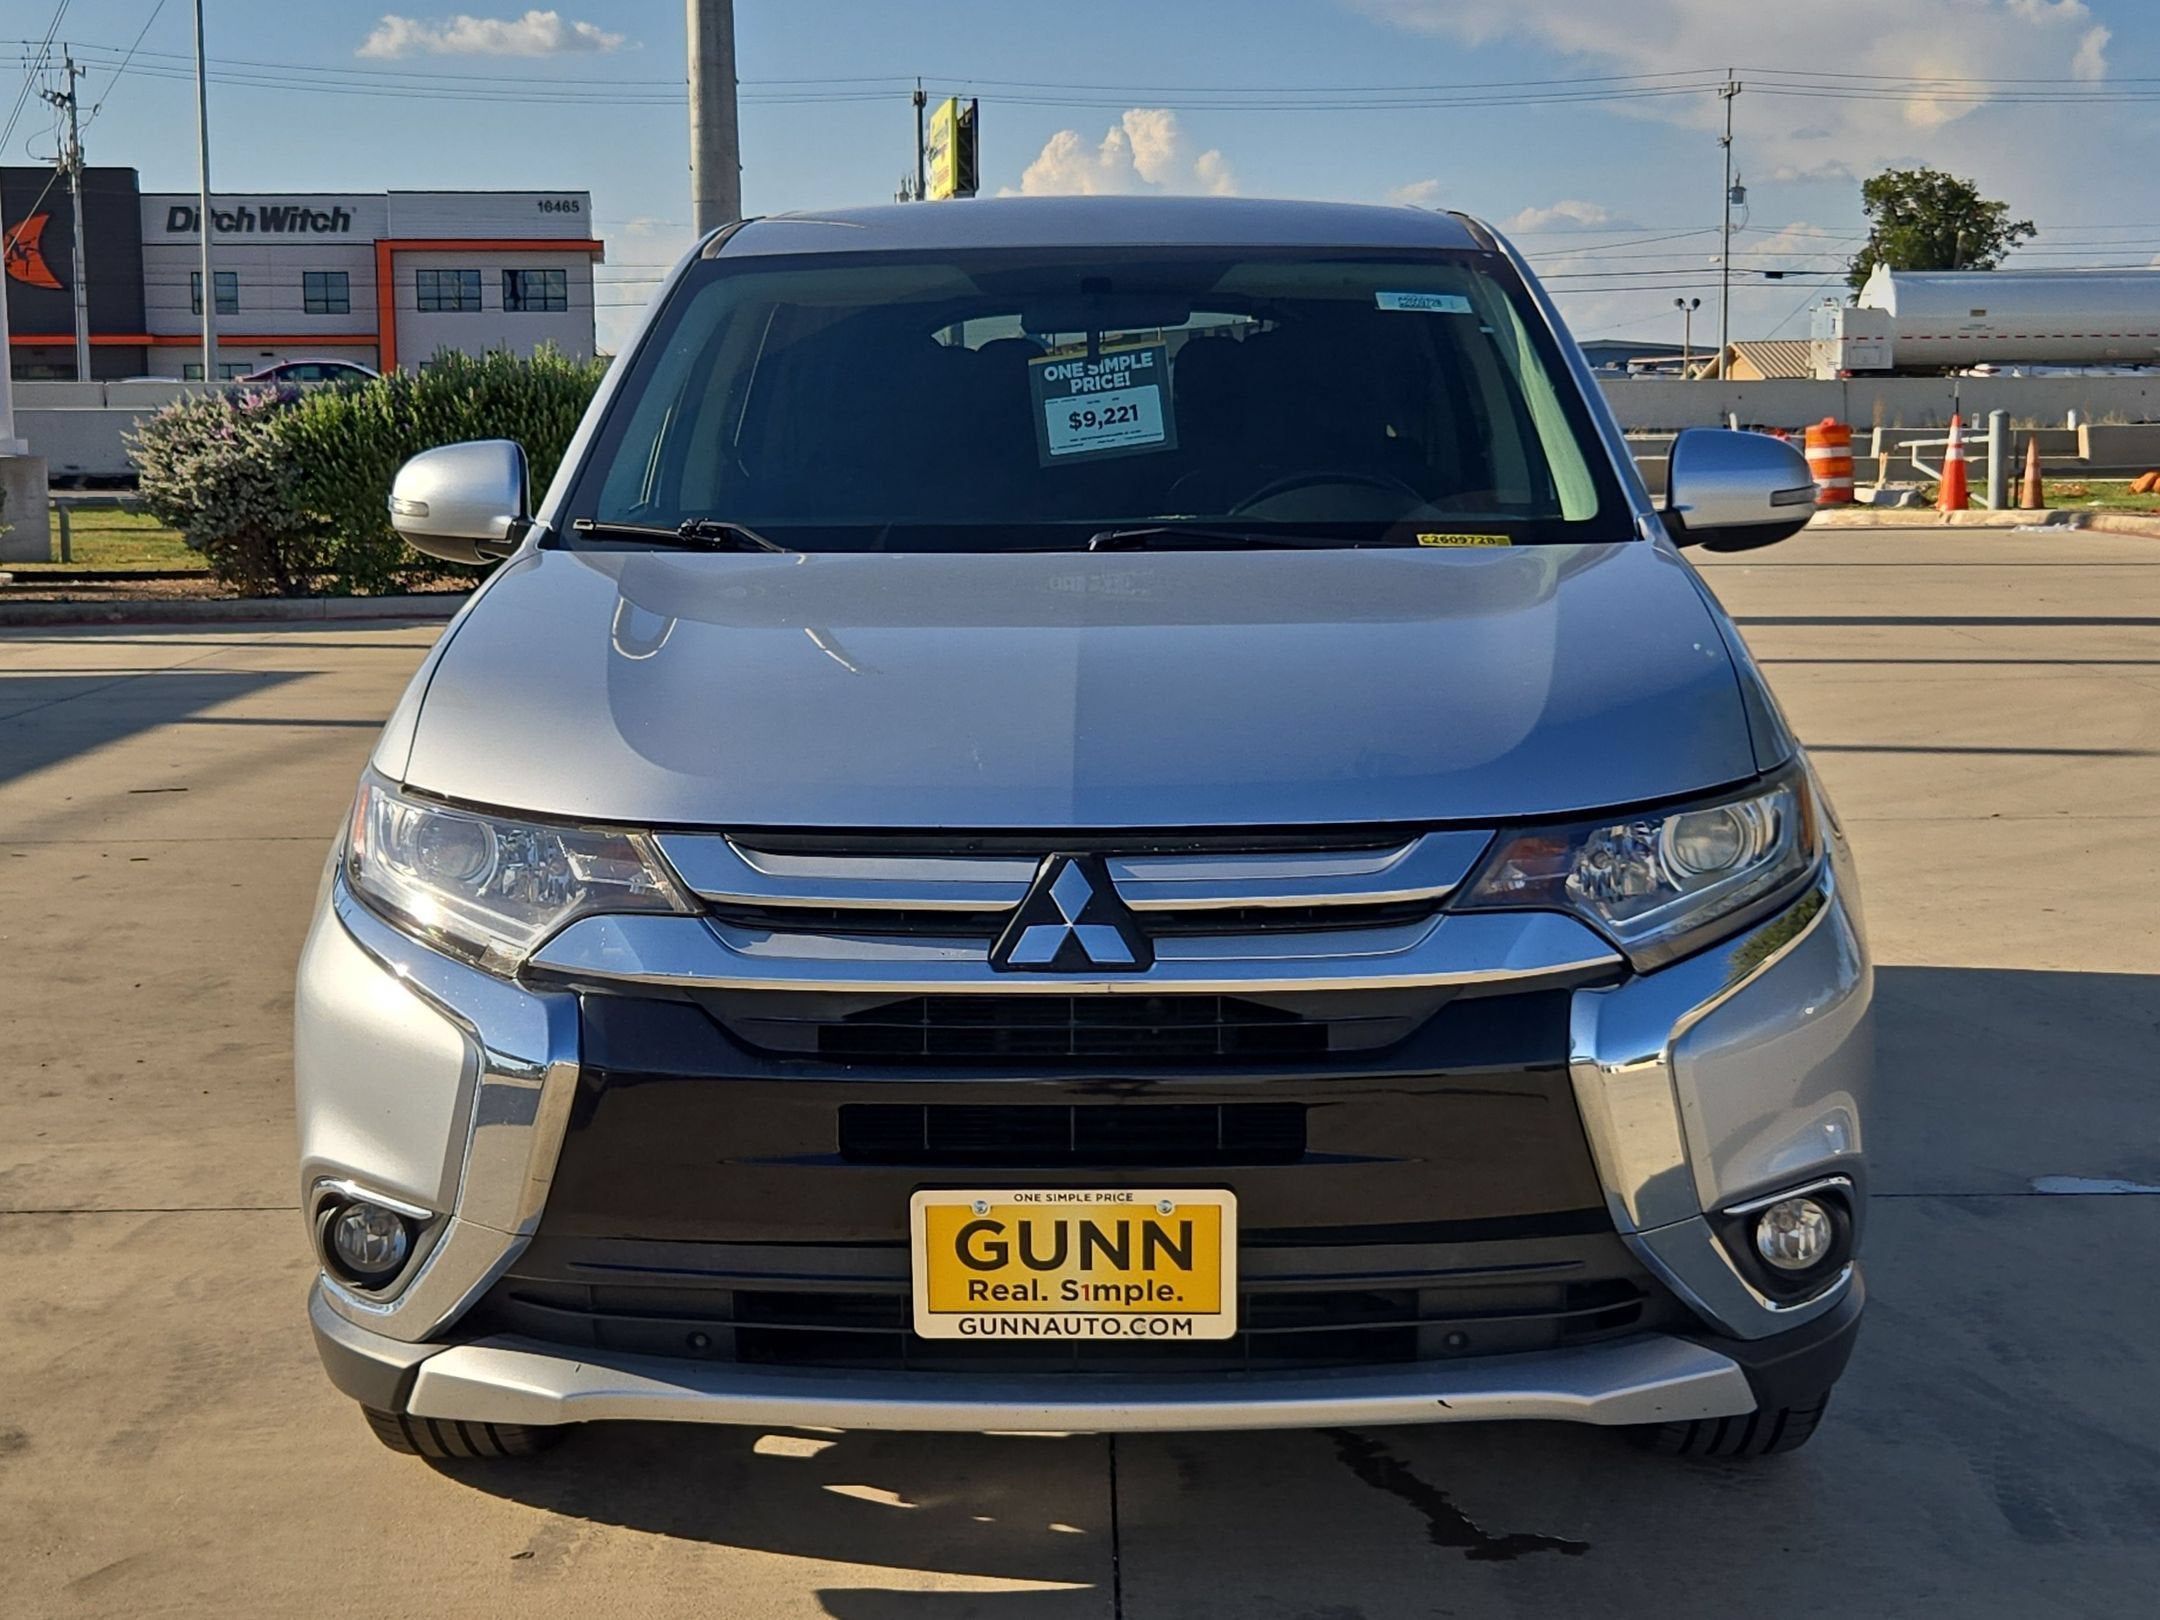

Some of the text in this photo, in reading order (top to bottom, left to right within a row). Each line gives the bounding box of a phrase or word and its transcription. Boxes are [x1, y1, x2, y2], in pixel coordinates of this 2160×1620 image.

[537, 200, 580, 213] 16465
[166, 206, 352, 233] Dich Witch
[1044, 352, 1153, 382] ONE SIMPLE
[1070, 371, 1131, 394] PRICE!
[1068, 404, 1139, 431] $9,221
[1013, 1192, 1134, 1203] ONE SIMPLE PRICE
[954, 1219, 1193, 1272] GUNN
[968, 1278, 1049, 1302] Real.
[958, 1317, 1193, 1336] GUNNAUTO.COM
